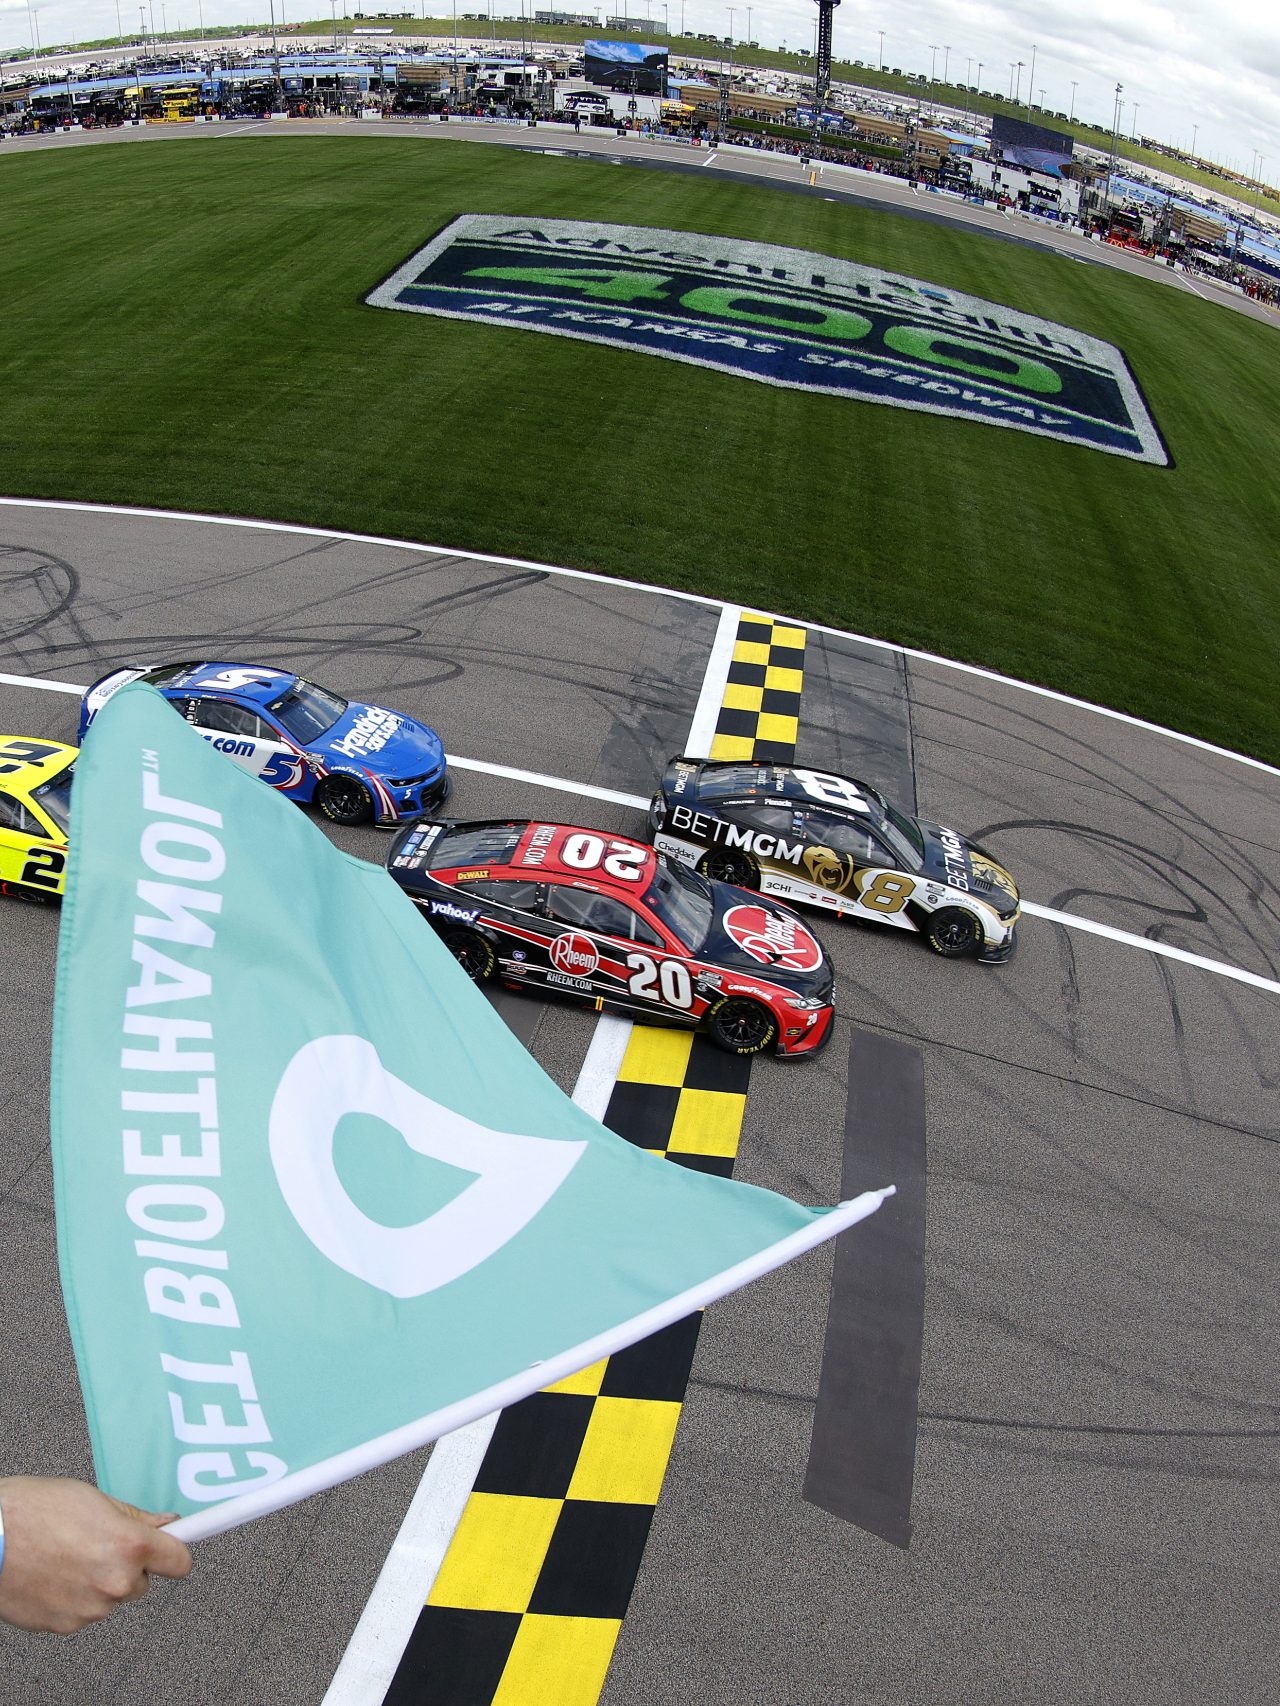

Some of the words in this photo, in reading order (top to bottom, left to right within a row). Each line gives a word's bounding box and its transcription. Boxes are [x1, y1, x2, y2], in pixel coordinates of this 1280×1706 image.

[492, 229, 1085, 358] AdventHealth
[463, 267, 1063, 394] 400
[465, 302, 549, 315] AT
[548, 310, 784, 354] KANSAS
[798, 352, 1072, 426] SPEEDWAY
[329, 705, 392, 759] Hendrick
[258, 752, 302, 787] 5
[404, 789, 412, 799] 5
[791, 769, 871, 813] 8
[521, 825, 557, 865] RHEEM.COM
[658, 841, 696, 861] Cheddar's
[672, 804, 804, 866] BETMGM
[20, 848, 66, 890] 2
[562, 833, 649, 882] 20
[939, 825, 969, 892] BETMGM
[766, 881, 793, 893] 3CHI
[860, 872, 916, 914] 8
[431, 901, 478, 922] yahoo!
[555, 934, 596, 970] Rheem
[546, 972, 593, 991] RHEEM.COM
[627, 953, 693, 1009] 20
[728, 984, 773, 1000] GOODYEAR
[806, 1013, 818, 1026] 20
